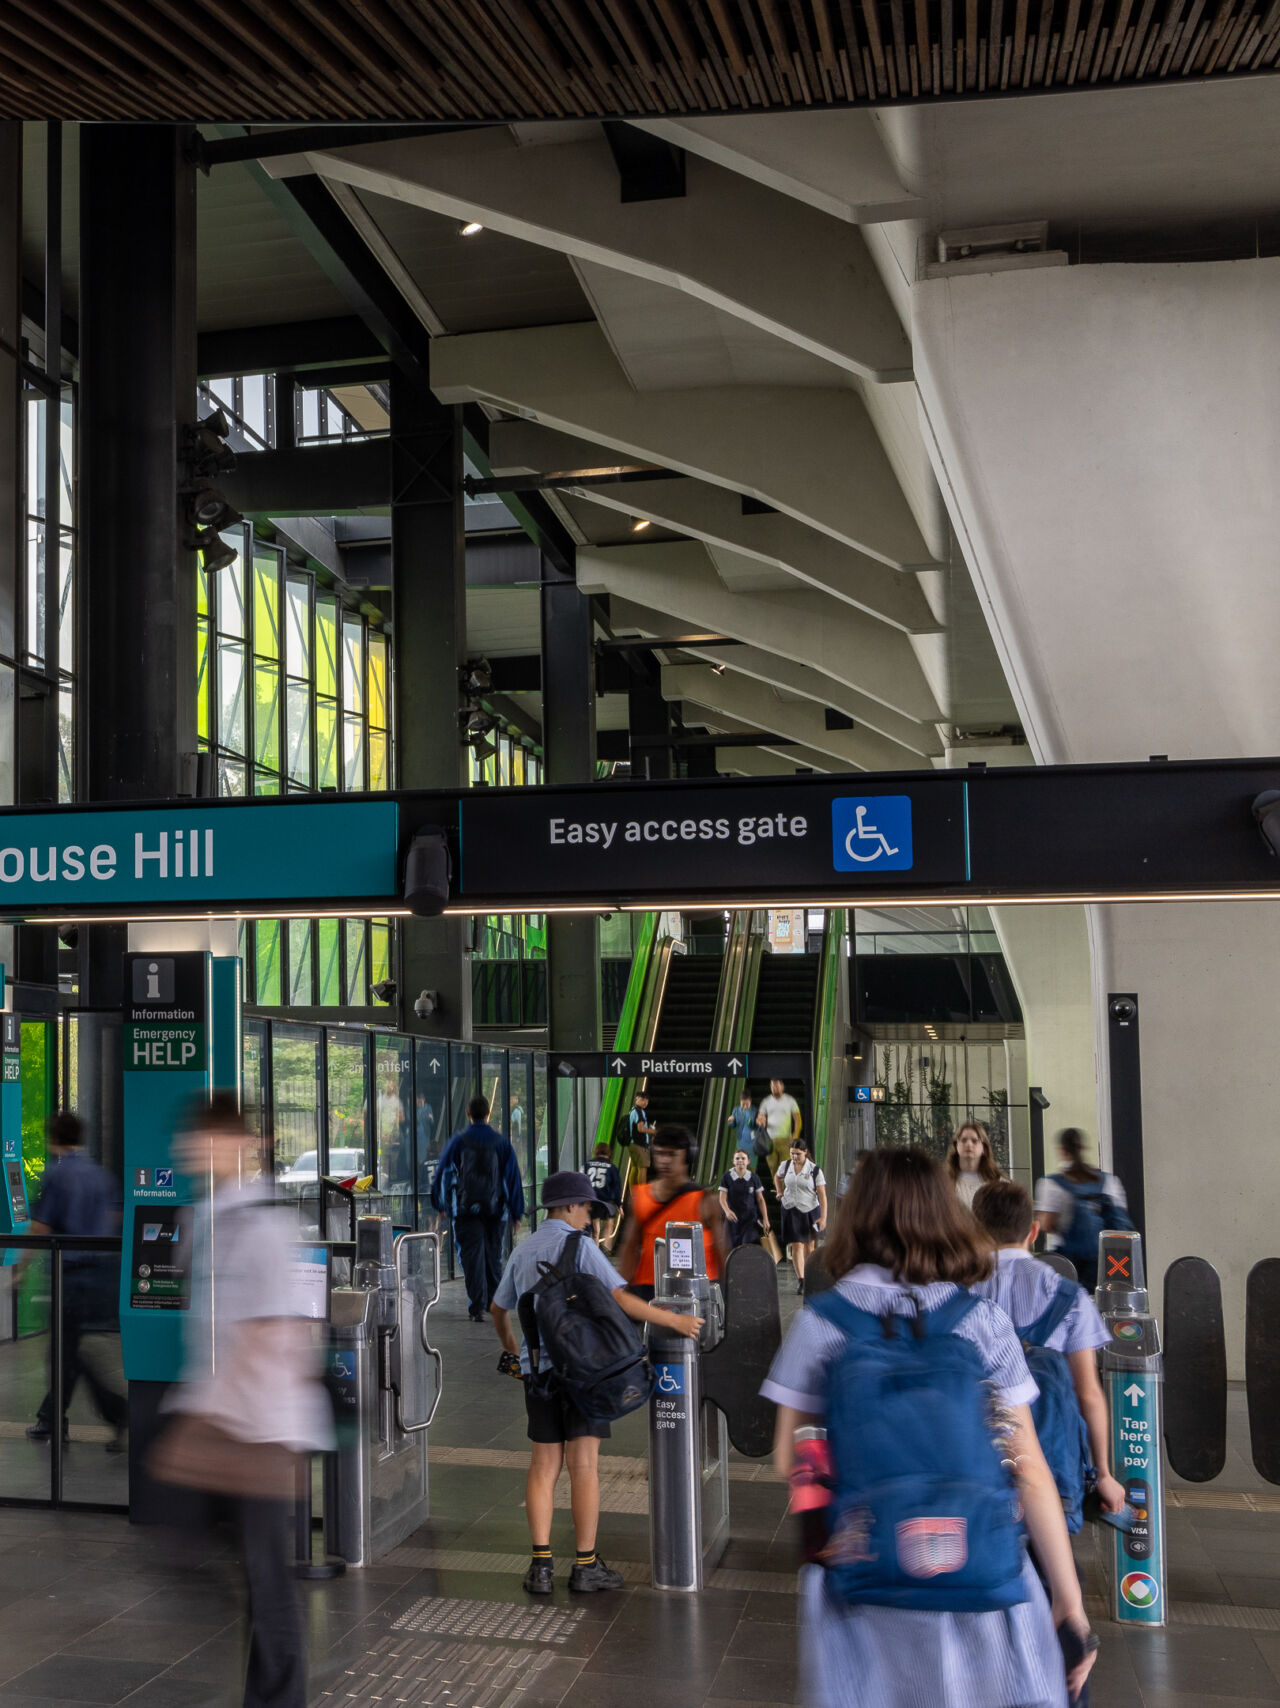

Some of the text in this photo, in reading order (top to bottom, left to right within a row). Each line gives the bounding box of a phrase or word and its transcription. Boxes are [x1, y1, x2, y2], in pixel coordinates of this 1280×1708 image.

[549, 812, 808, 849] Easy access gate
[134, 828, 214, 879] Hill
[132, 1008, 195, 1020] Information
[133, 1027, 196, 1041] Emergency
[133, 1042, 196, 1065] HELP
[4, 1065, 20, 1080] HELP
[641, 1059, 713, 1073] Platforms
[587, 1166, 608, 1189] 25
[133, 1189, 177, 1198] Information
[656, 1399, 676, 1411] Easy
[656, 1410, 686, 1419] access
[656, 1420, 676, 1430] gate
[1122, 1417, 1148, 1431] Tap
[1120, 1428, 1152, 1442] here
[1128, 1443, 1144, 1454] to
[1124, 1456, 1149, 1469] pay
[1131, 1527, 1148, 1535] VISA
